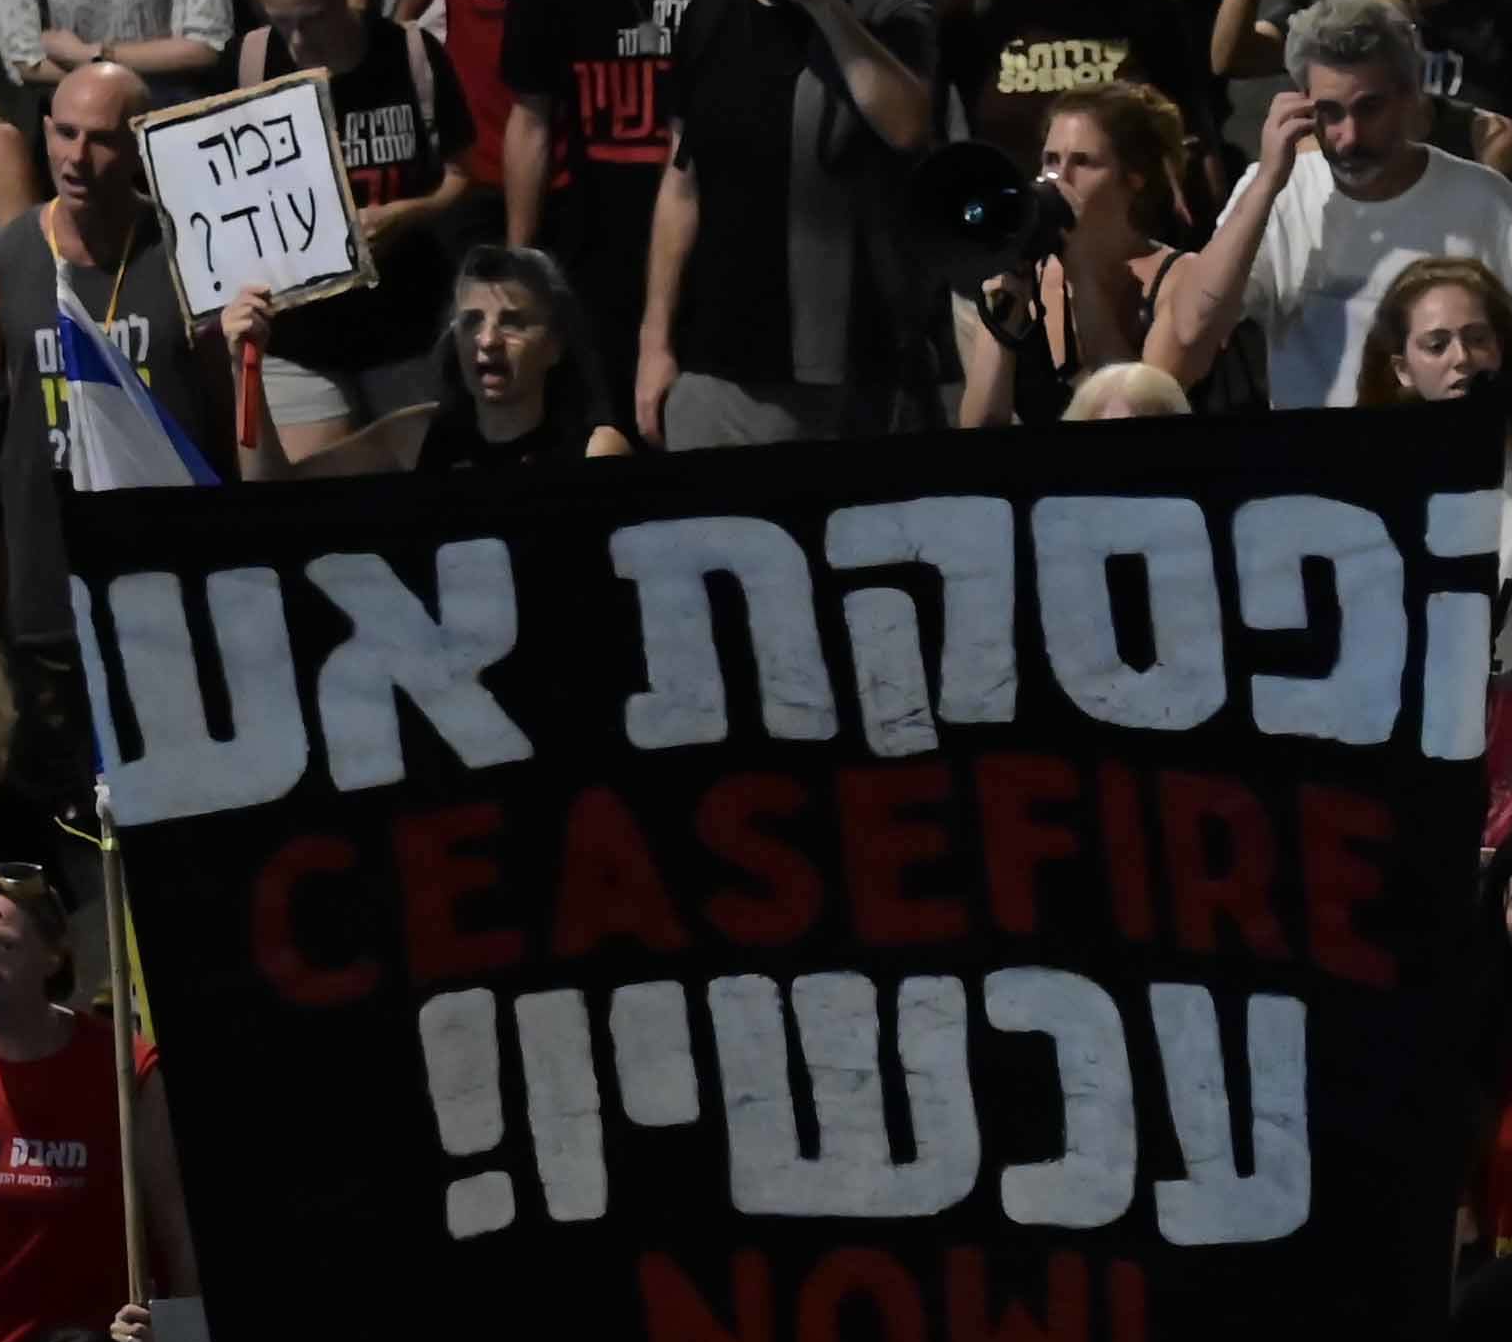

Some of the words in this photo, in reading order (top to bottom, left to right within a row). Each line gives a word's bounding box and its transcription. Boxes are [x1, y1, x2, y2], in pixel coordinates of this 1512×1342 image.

[72, 535, 534, 829] אש
[249, 752, 1399, 1010] CEASEFIRE
[416, 967, 1312, 1247] עכשיו!
